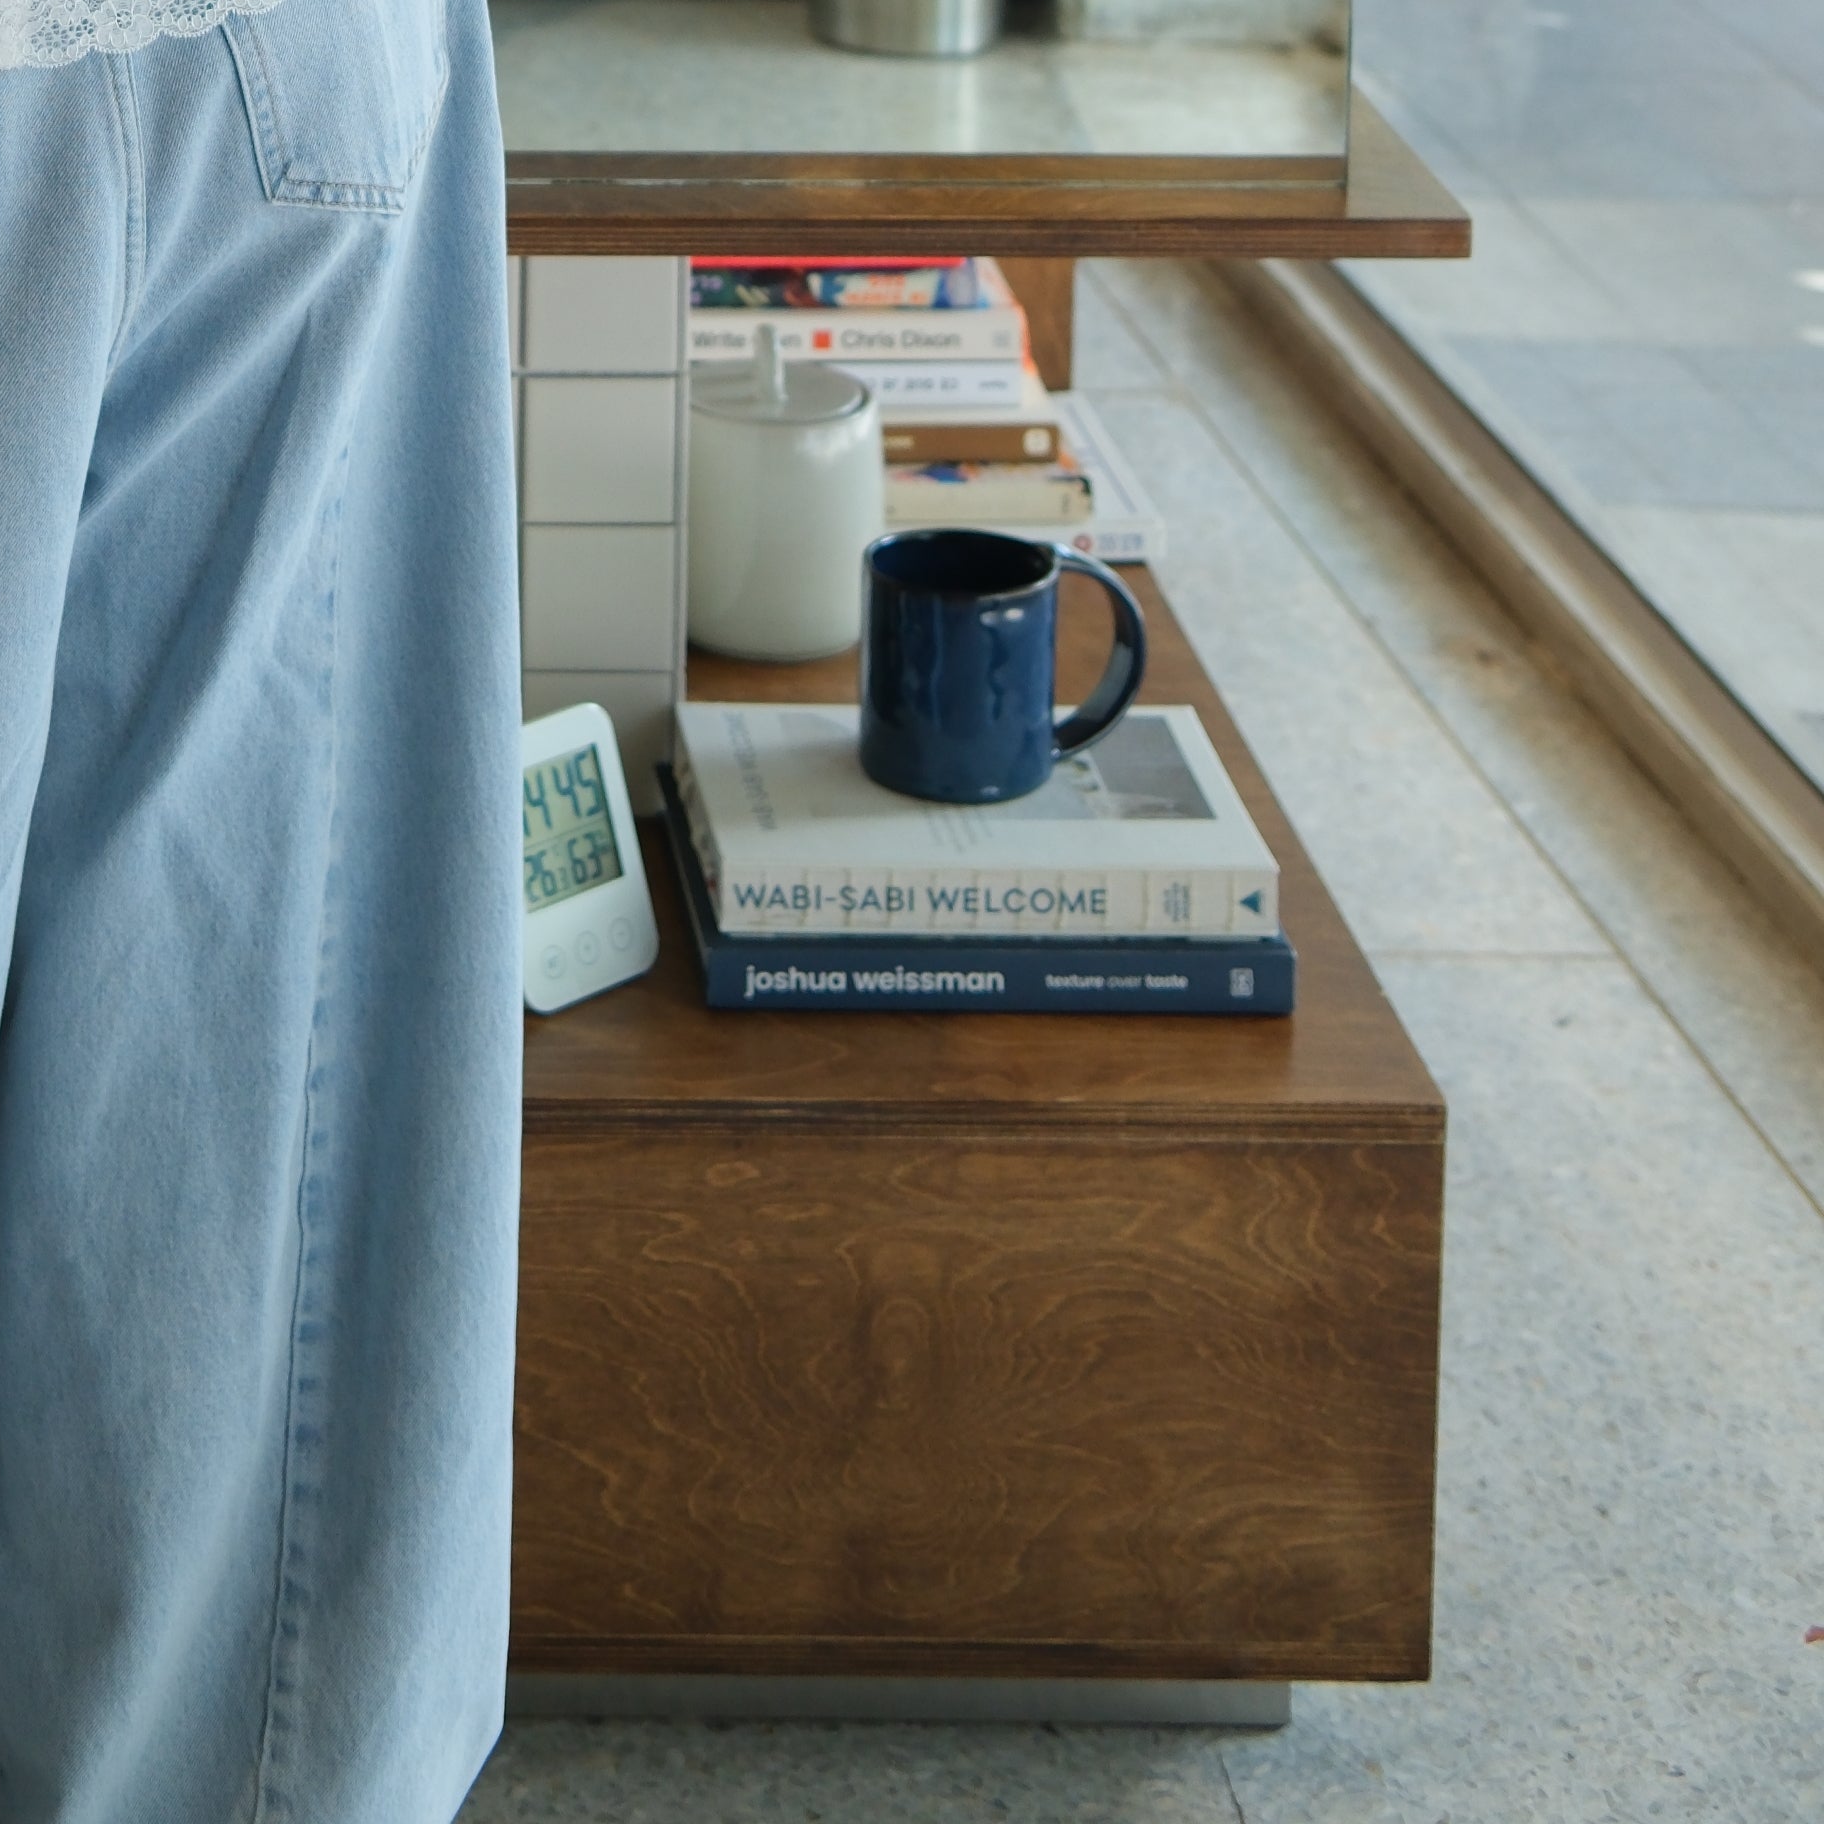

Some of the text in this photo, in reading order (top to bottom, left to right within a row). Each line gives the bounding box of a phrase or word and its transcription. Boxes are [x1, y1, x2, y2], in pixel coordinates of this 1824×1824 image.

[839, 328, 962, 350] Chris Dixon
[733, 882, 1108, 916] WABI-SABI WELCOME
[743, 964, 1006, 997] joshua weissman
[1044, 973, 1105, 991] texture
[1145, 973, 1189, 990] taste
